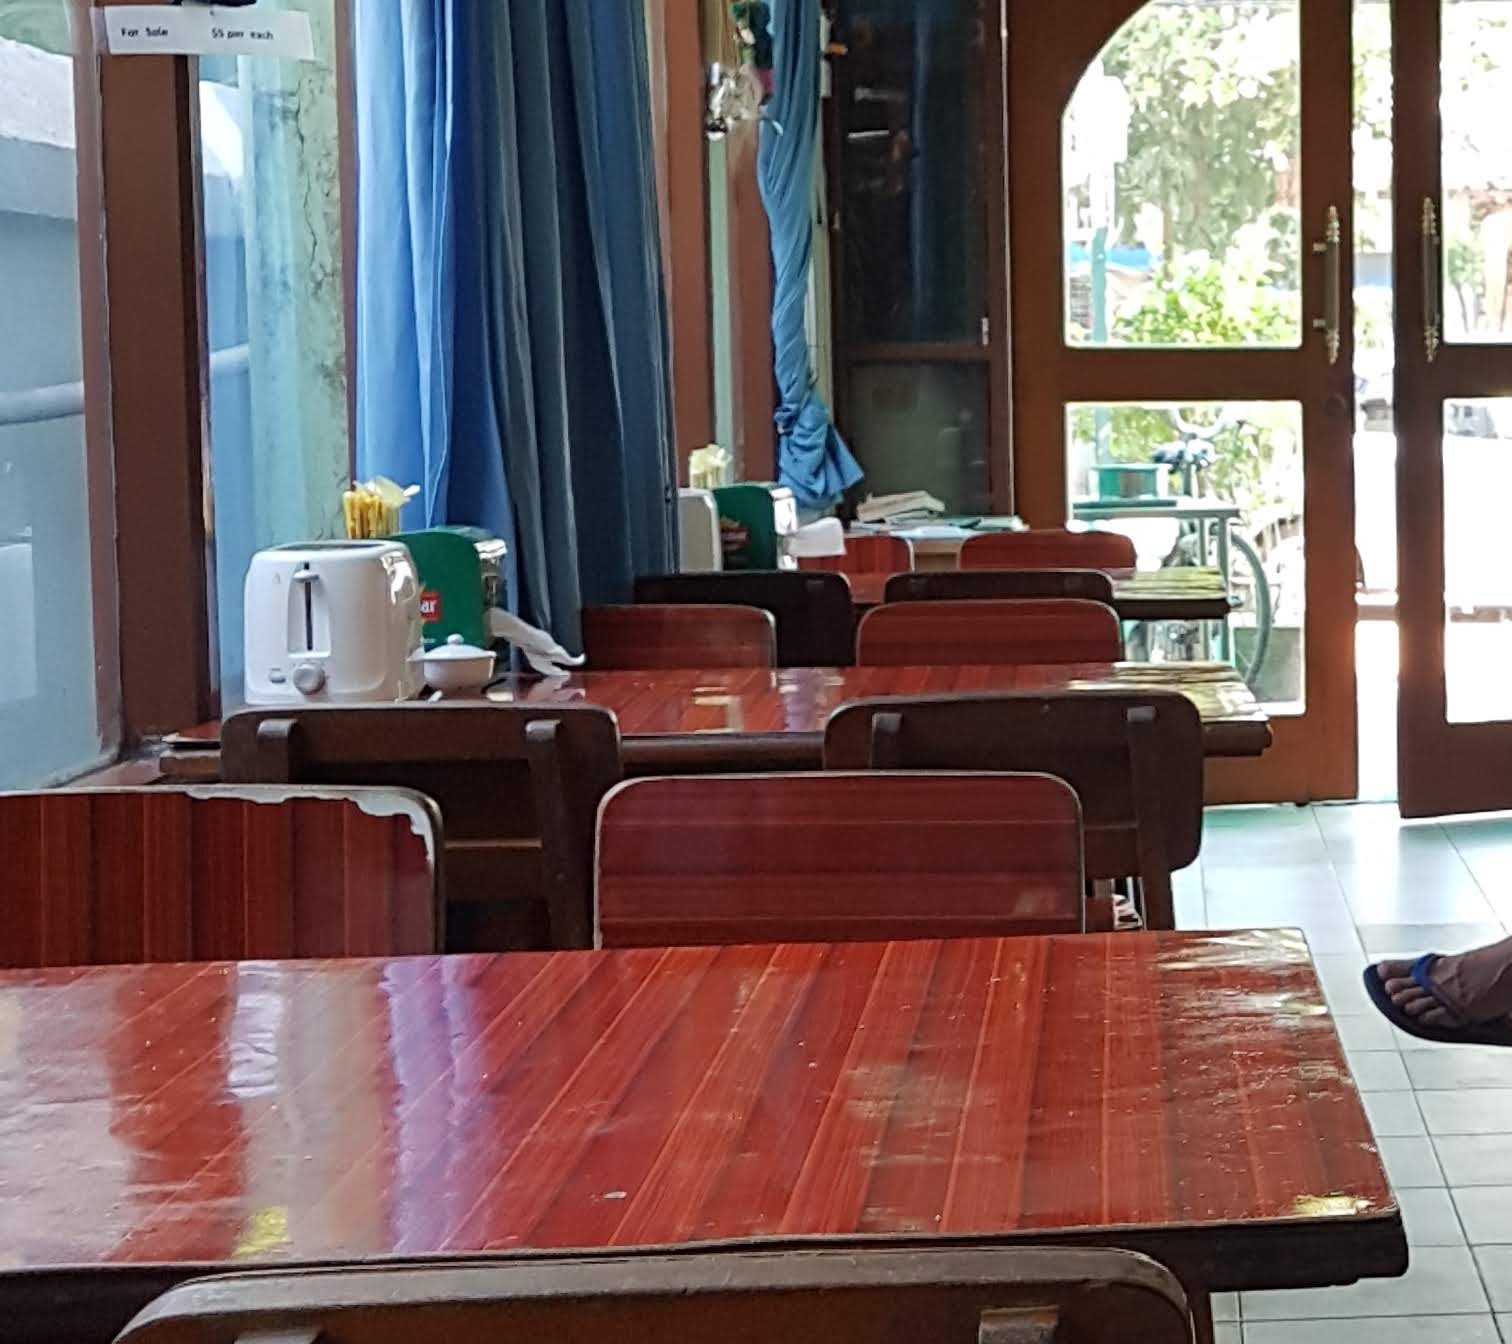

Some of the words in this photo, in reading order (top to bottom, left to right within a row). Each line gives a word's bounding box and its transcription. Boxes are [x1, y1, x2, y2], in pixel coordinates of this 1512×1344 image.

[121, 28, 139, 37] For
[227, 29, 244, 39] per
[250, 30, 274, 40] each
